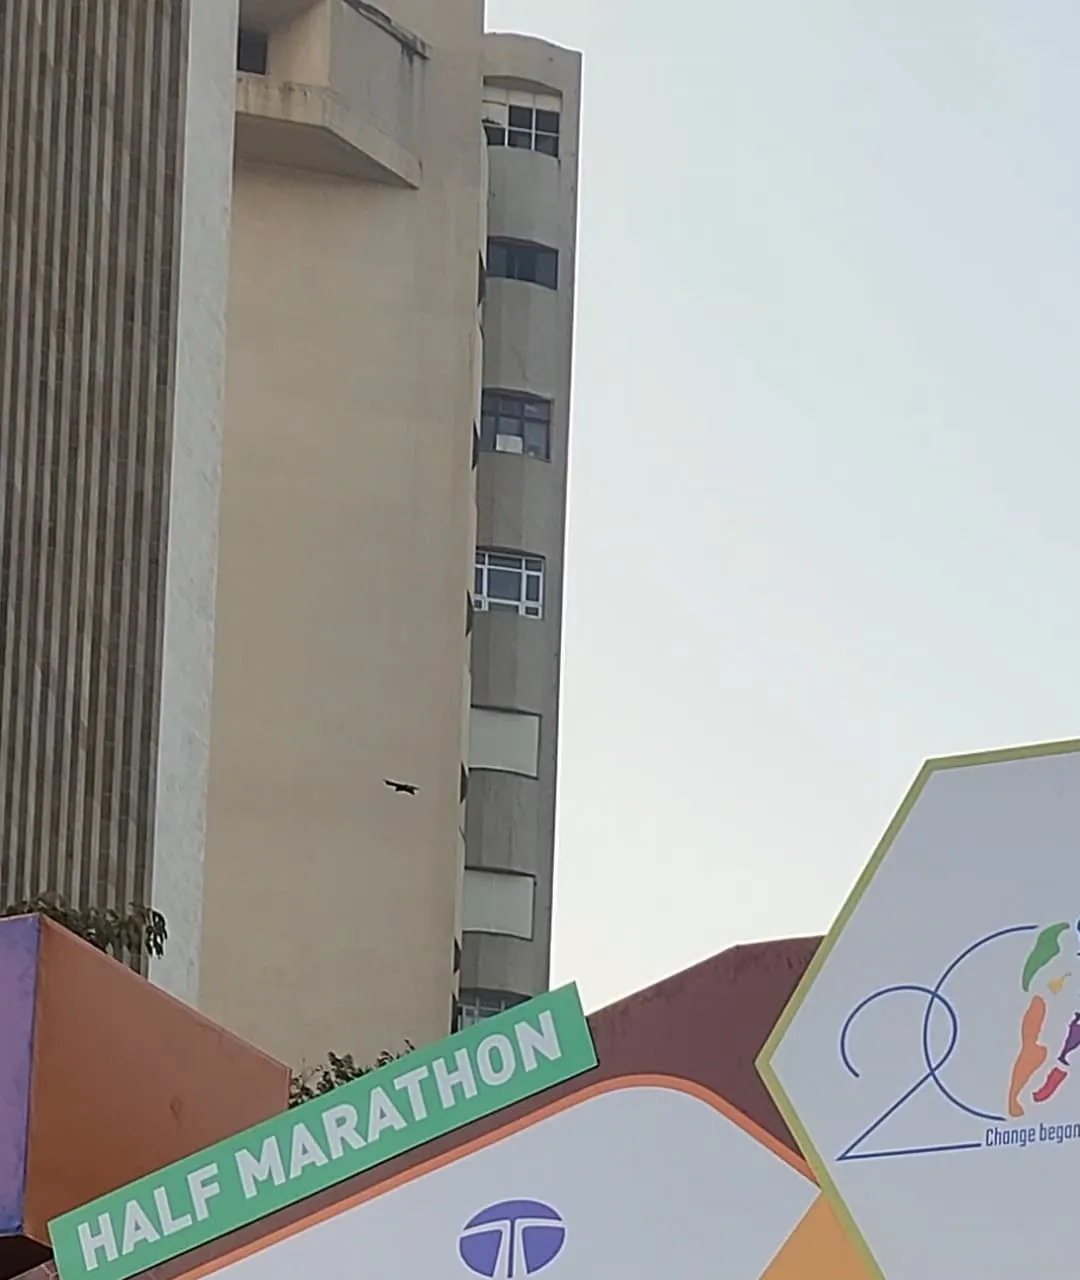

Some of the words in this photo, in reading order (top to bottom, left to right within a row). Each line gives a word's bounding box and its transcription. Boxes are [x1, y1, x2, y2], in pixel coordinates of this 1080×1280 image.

[76, 1162, 221, 1271] HALF
[234, 1010, 564, 1199] MARATHON
[985, 1127, 1036, 1148] Change
